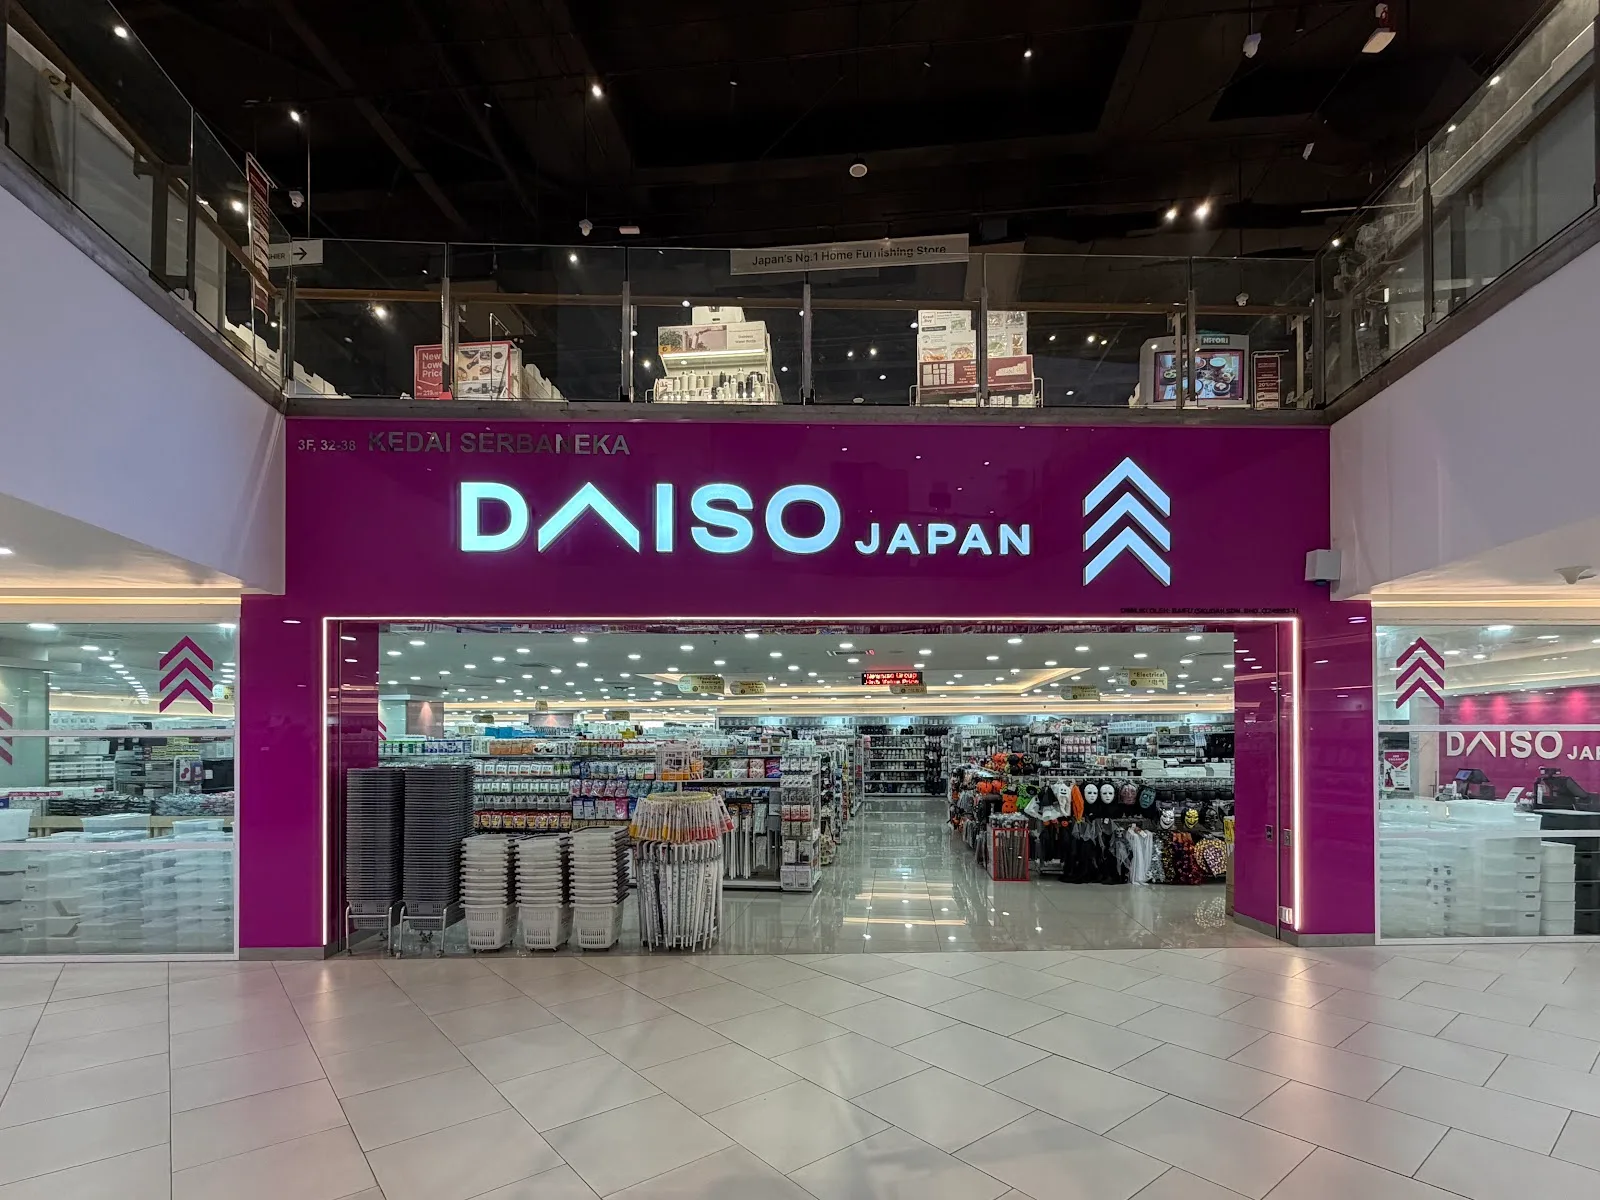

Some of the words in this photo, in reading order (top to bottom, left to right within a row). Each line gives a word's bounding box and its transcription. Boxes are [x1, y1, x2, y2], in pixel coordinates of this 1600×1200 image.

[752, 254, 793, 267] Japan's
[795, 252, 818, 263] No.1
[821, 251, 853, 262] Home
[916, 244, 946, 256] Store
[422, 353, 442, 361] New
[297, 439, 317, 452] 3F,
[320, 439, 357, 451] 32-38
[368, 431, 452, 453] KEDAI
[459, 432, 632, 456] SERBANEKA
[460, 481, 843, 554] DAISO
[854, 522, 1032, 556] JAPAN
[1446, 731, 1563, 759] DAISO
